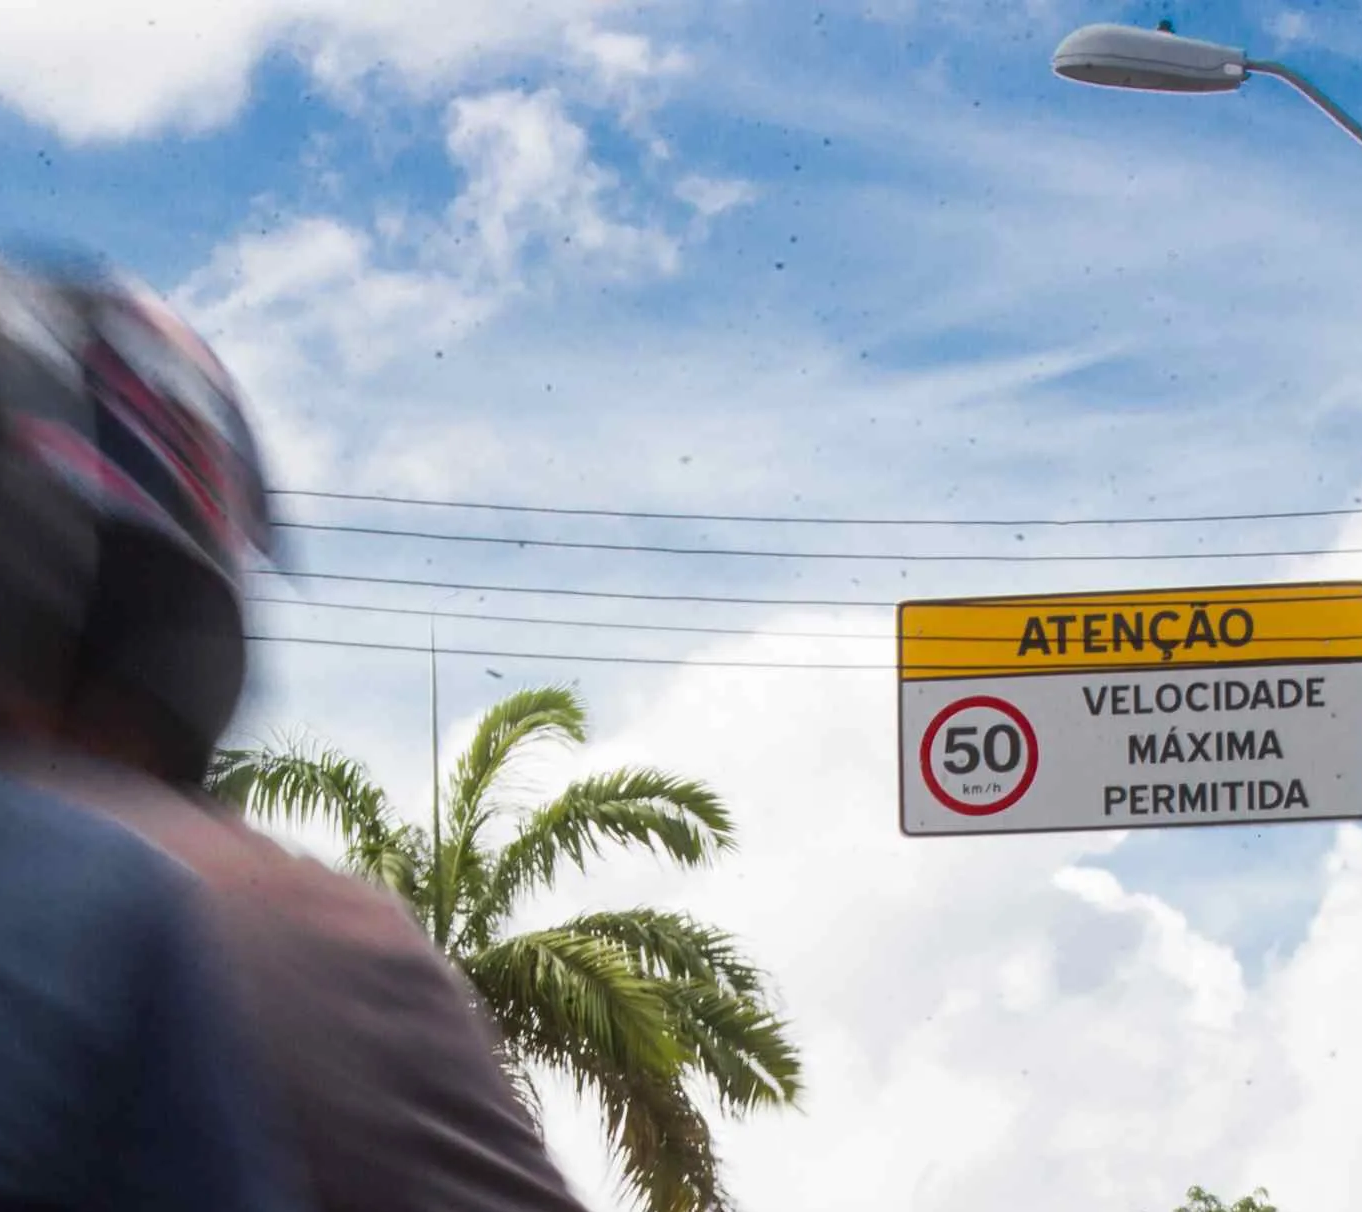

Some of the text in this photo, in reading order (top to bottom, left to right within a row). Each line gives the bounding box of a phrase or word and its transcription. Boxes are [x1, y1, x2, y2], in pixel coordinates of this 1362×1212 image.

[1017, 602, 1254, 661] ATENÇÃO
[1082, 677, 1326, 716] VELOCIDADE
[943, 724, 1021, 774] 50
[1128, 726, 1284, 765] MÁXIMA
[962, 783, 1002, 796] km/h
[1104, 779, 1310, 815] PERMITIDA
